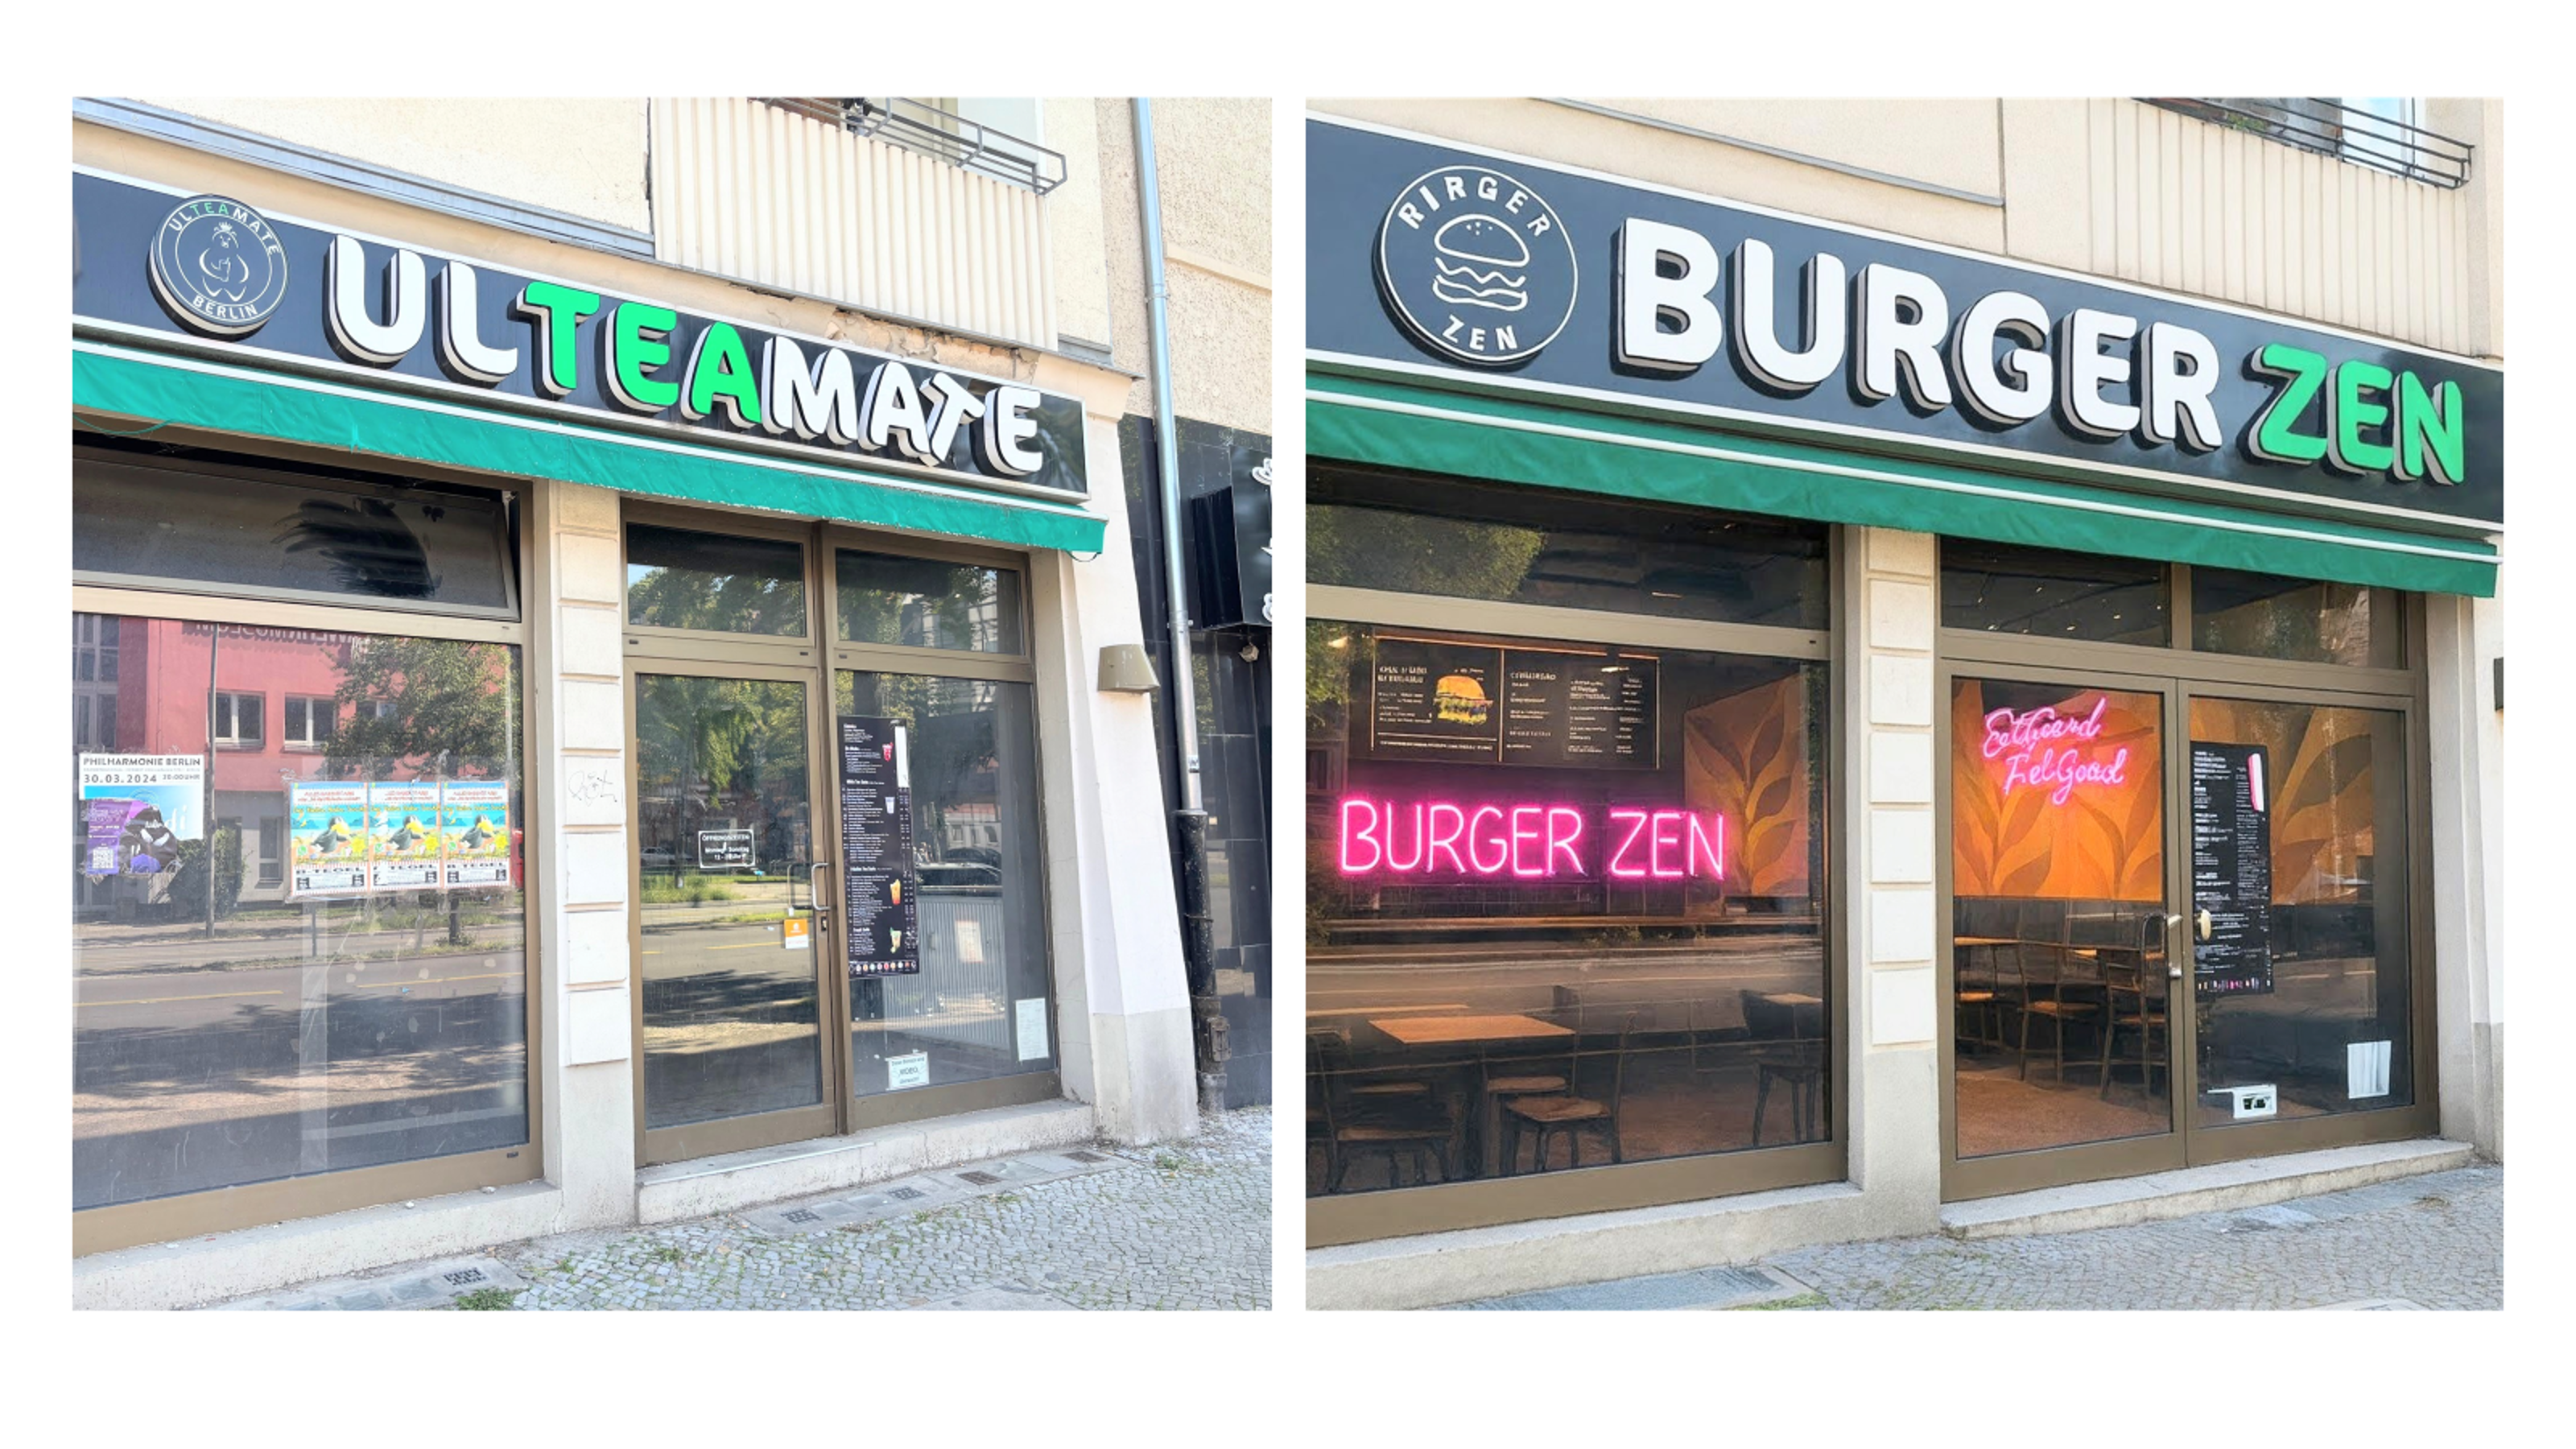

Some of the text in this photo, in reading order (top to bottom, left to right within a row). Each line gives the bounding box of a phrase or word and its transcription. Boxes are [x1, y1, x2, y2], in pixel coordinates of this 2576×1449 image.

[168, 201, 281, 255] ULTEAMATE
[1397, 175, 1551, 237] RIRGER
[192, 295, 258, 320] BERLIN
[1442, 314, 1518, 351] ZEN
[327, 233, 1045, 477] ULTEAMATE
[1618, 216, 2466, 485] BURGER ZEN
[83, 758, 200, 766] PHILHARMONIE BERLIN
[84, 774, 158, 783] 30.03.2024
[1338, 798, 1726, 881] BURGER ZEN
